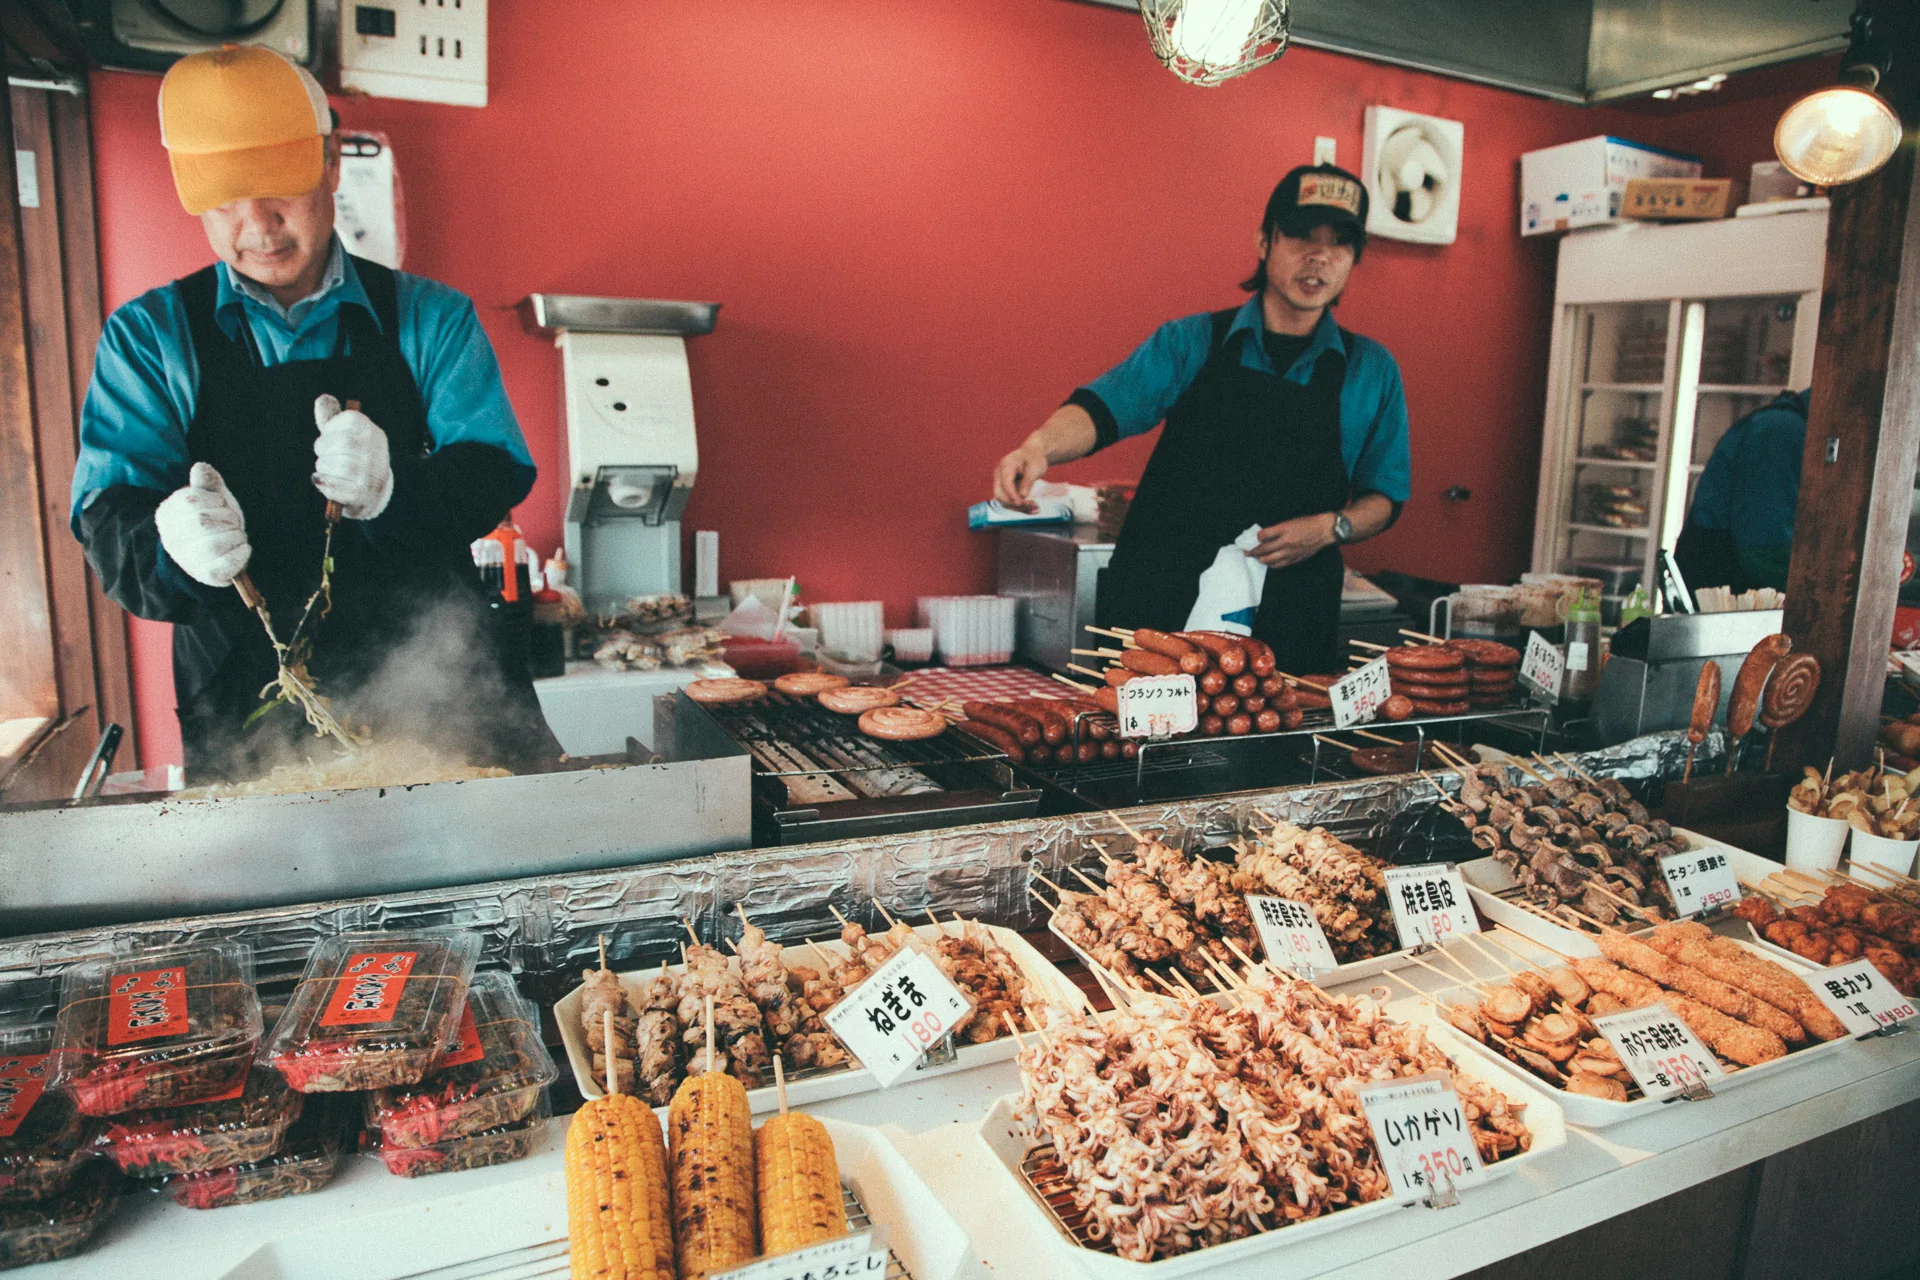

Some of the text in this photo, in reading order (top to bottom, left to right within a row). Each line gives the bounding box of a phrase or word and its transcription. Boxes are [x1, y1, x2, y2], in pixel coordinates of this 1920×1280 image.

[1128, 686, 1190, 699] フランクフルト
[1340, 666, 1385, 701] 激辛フランク
[1353, 690, 1376, 716] 350
[1667, 855, 1726, 880] 牛タン串焼き
[1401, 877, 1457, 915] 焼き鳥皮
[1259, 899, 1313, 928] 焼き鳥もも
[1425, 913, 1452, 936] 180
[1285, 933, 1311, 953] 180
[1824, 973, 1872, 999] 串カツ
[865, 975, 927, 1036] ねぎま
[901, 1010, 942, 1051] 180
[1620, 1022, 1689, 1056] ホタテ串焼き
[1385, 1108, 1460, 1147] いかゲソ
